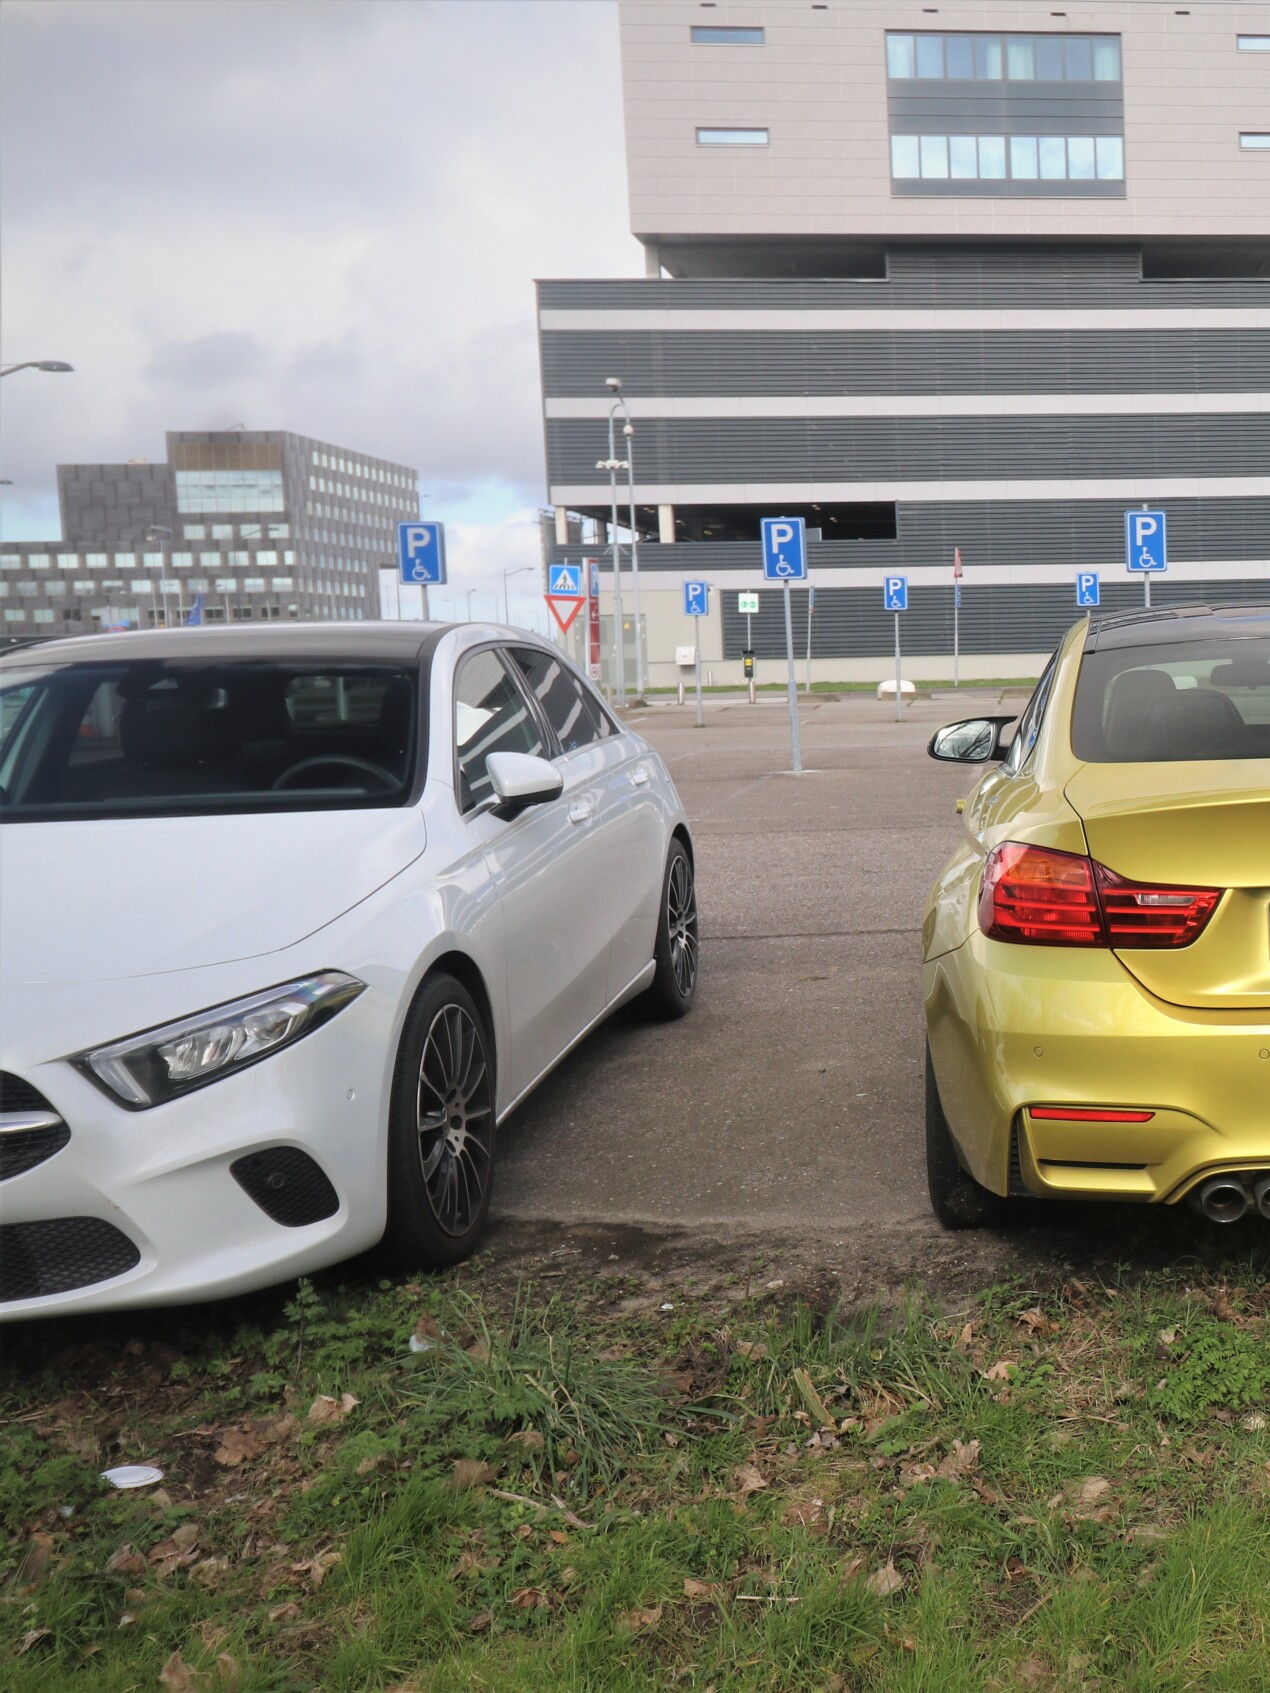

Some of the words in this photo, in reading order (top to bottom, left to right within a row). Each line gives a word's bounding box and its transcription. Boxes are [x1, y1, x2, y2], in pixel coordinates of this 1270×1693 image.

[408, 528, 430, 557] P
[772, 524, 793, 553] P
[1136, 517, 1157, 545] P
[689, 583, 702, 601] P
[890, 578, 902, 596] P
[1082, 575, 1094, 592] P
